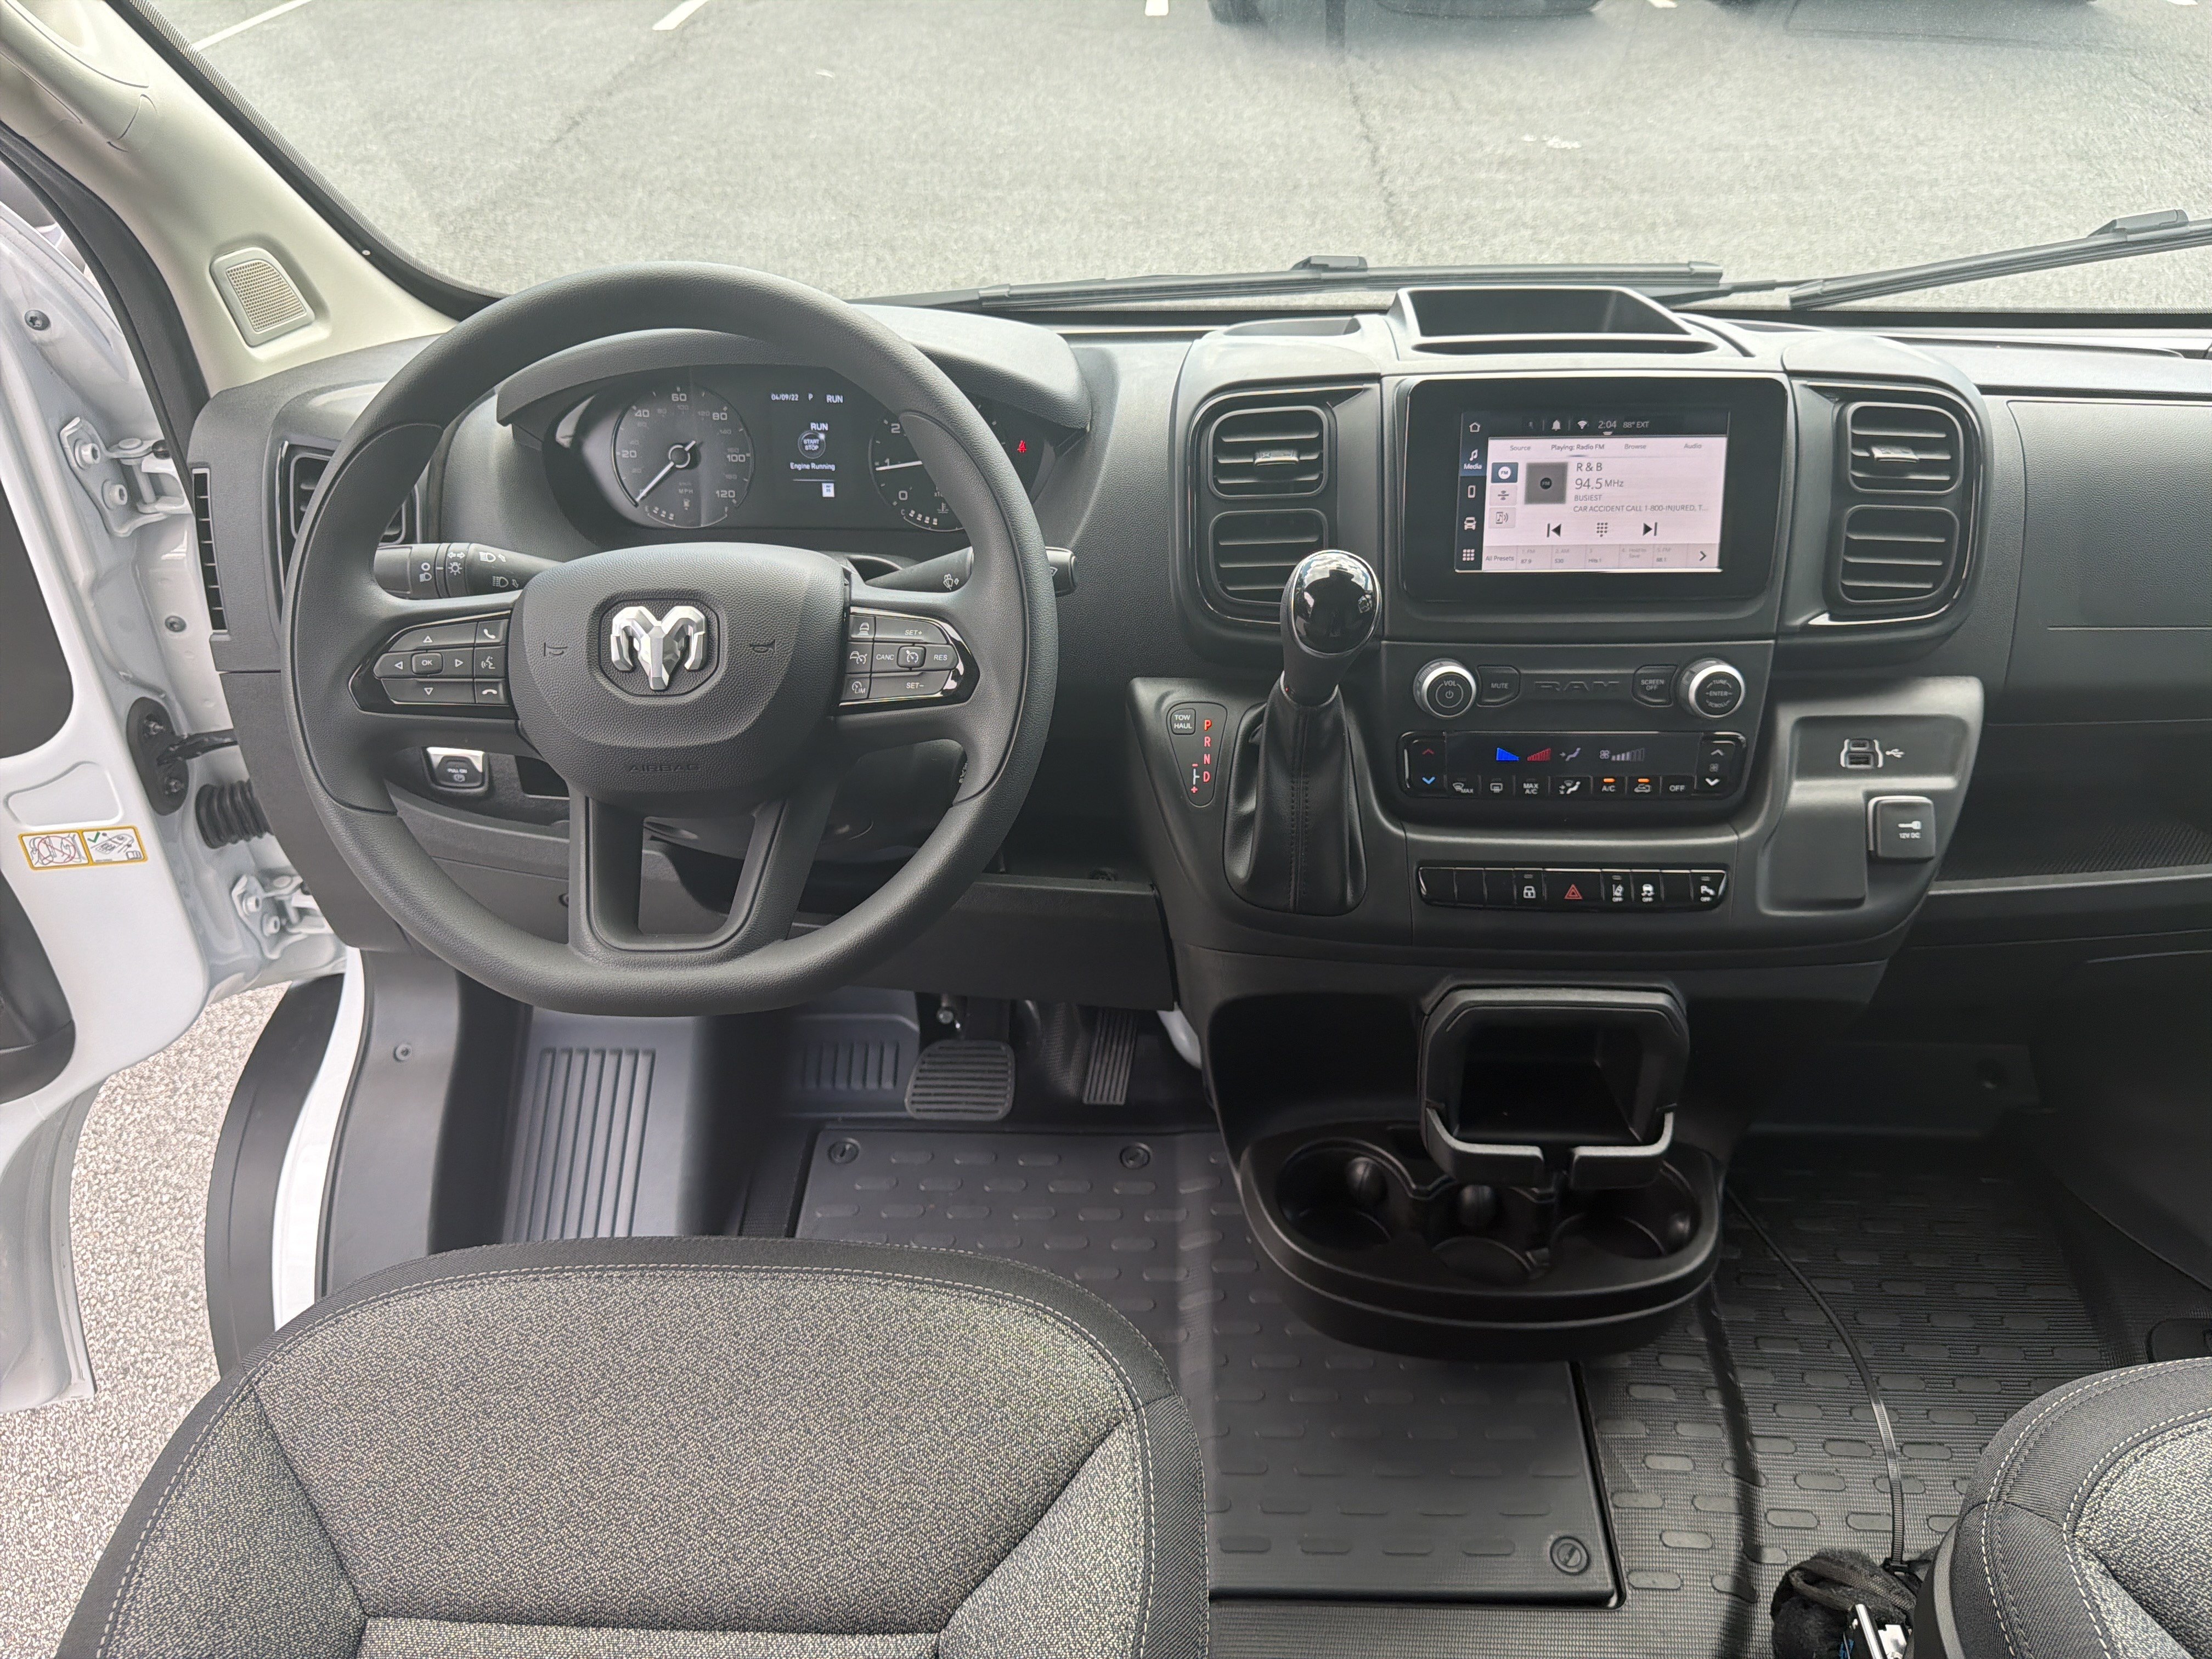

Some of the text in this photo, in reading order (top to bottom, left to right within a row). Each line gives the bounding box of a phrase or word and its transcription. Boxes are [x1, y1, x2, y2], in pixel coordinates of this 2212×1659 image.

[672, 393, 687, 402] 60
[771, 393, 799, 401] 04/09/22
[826, 394, 843, 403] RUN
[810, 422, 828, 431] RUN
[891, 423, 901, 433] 2
[789, 462, 836, 471] Engine Running
[1576, 462, 1602, 471] R & B
[1575, 478, 1602, 489] 94.5
[898, 490, 908, 500] 0
[1204, 719, 1212, 731] P
[1204, 736, 1211, 747] R
[1204, 753, 1210, 764] N
[1203, 771, 1210, 782] D
